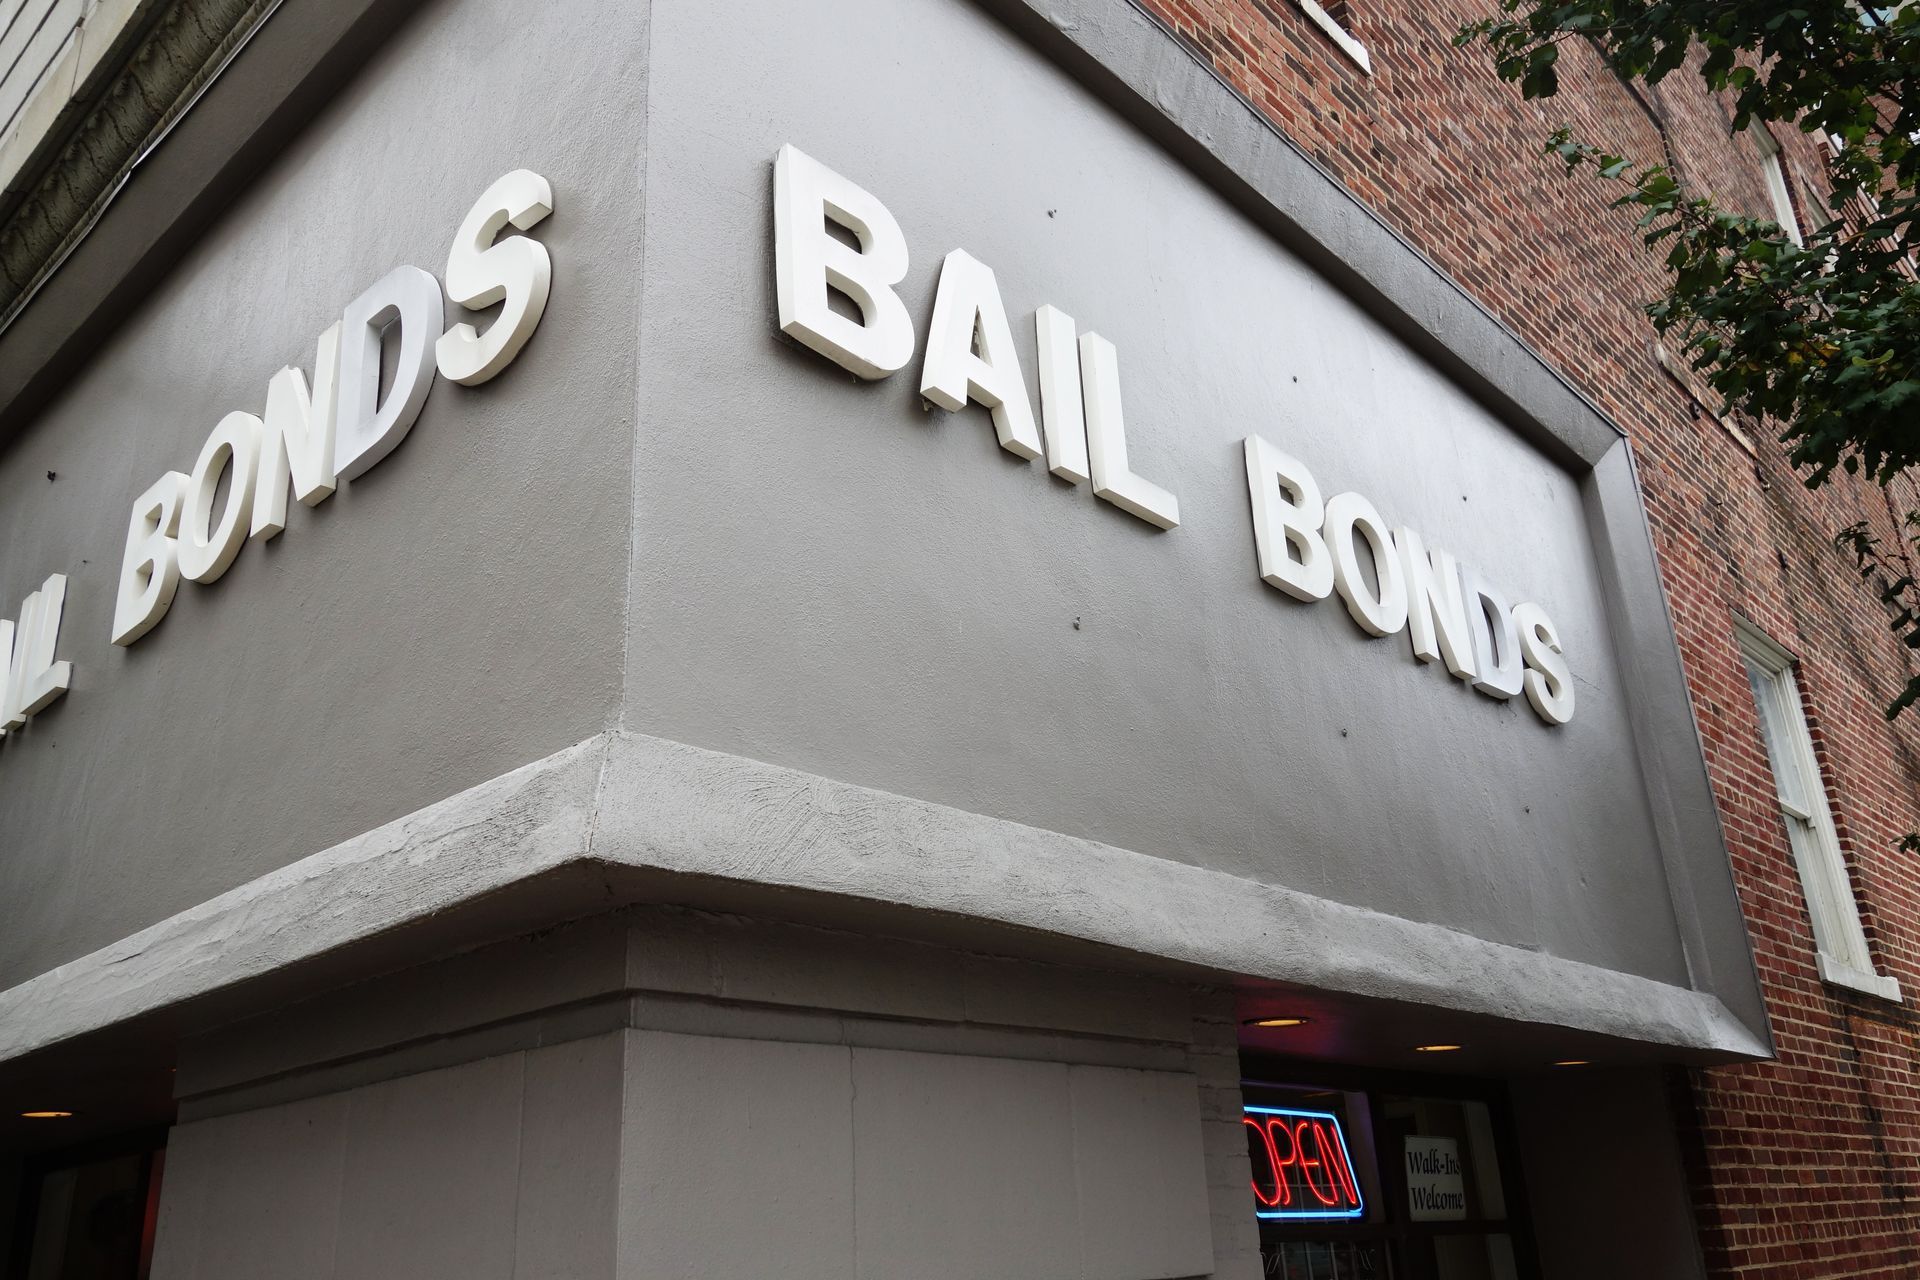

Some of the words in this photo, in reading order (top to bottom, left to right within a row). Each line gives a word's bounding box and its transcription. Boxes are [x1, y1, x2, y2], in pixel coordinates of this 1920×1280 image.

[111, 168, 554, 647] BONDS
[773, 143, 1180, 531] BAIL
[1243, 433, 1576, 725] BONDS
[1243, 1117, 1357, 1206] OPEN
[1407, 1148, 1463, 1177] Walk-Ins
[1411, 1184, 1464, 1211] Welcome
